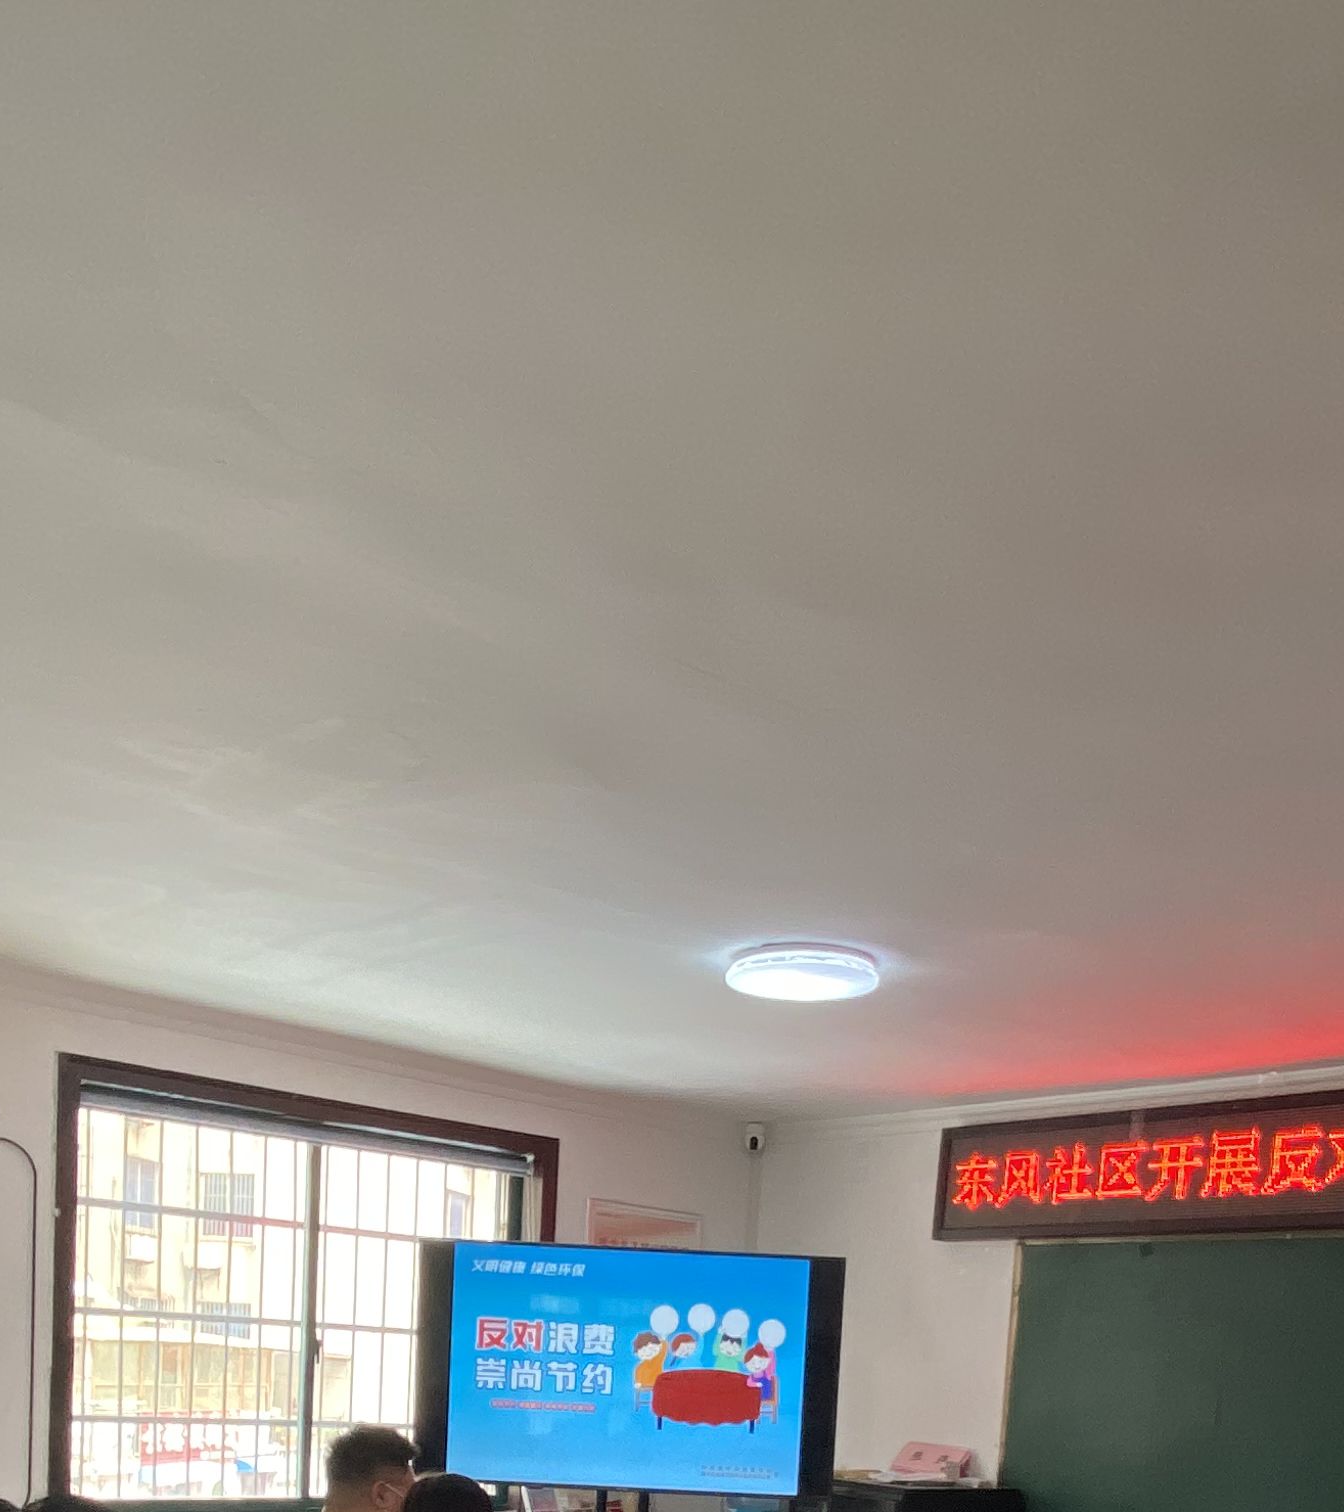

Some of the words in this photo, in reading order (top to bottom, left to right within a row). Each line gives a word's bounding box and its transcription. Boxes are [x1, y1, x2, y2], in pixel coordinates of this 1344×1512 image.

[475, 1316, 616, 1356] 反对浪费
[474, 1357, 614, 1396] 崇尚节约
